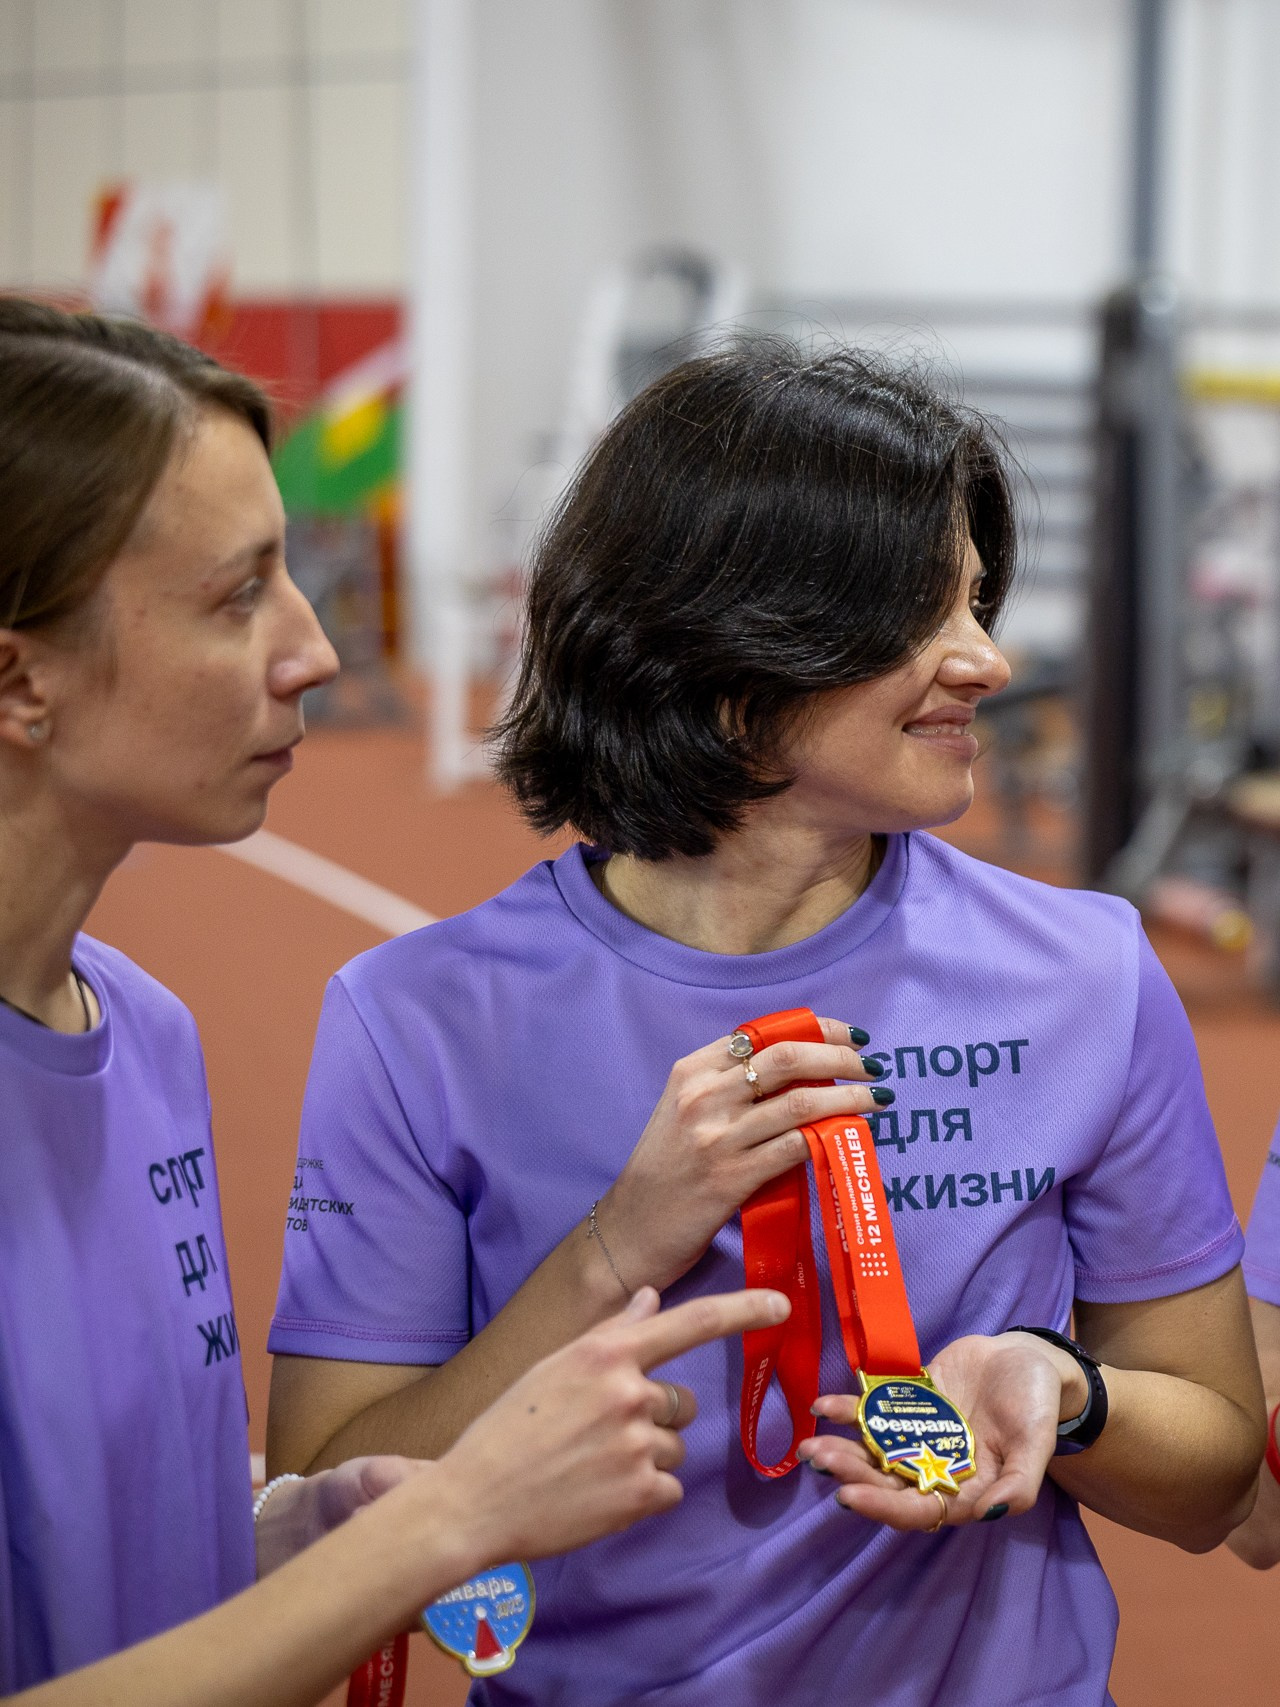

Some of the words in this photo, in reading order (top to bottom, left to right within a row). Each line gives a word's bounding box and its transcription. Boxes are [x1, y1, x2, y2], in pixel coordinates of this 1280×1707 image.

[868, 1038, 1030, 1088] спорт
[872, 1107, 973, 1154] для
[844, 1127, 878, 1222] МЕСЯЦЕВ
[884, 1166, 1056, 1213] жизни
[853, 1212, 865, 1246] Серия
[867, 1223, 882, 1247] 12
[175, 1233, 219, 1297] дл
[867, 1415, 964, 1437] Февраль
[437, 1575, 517, 1604] нварь
